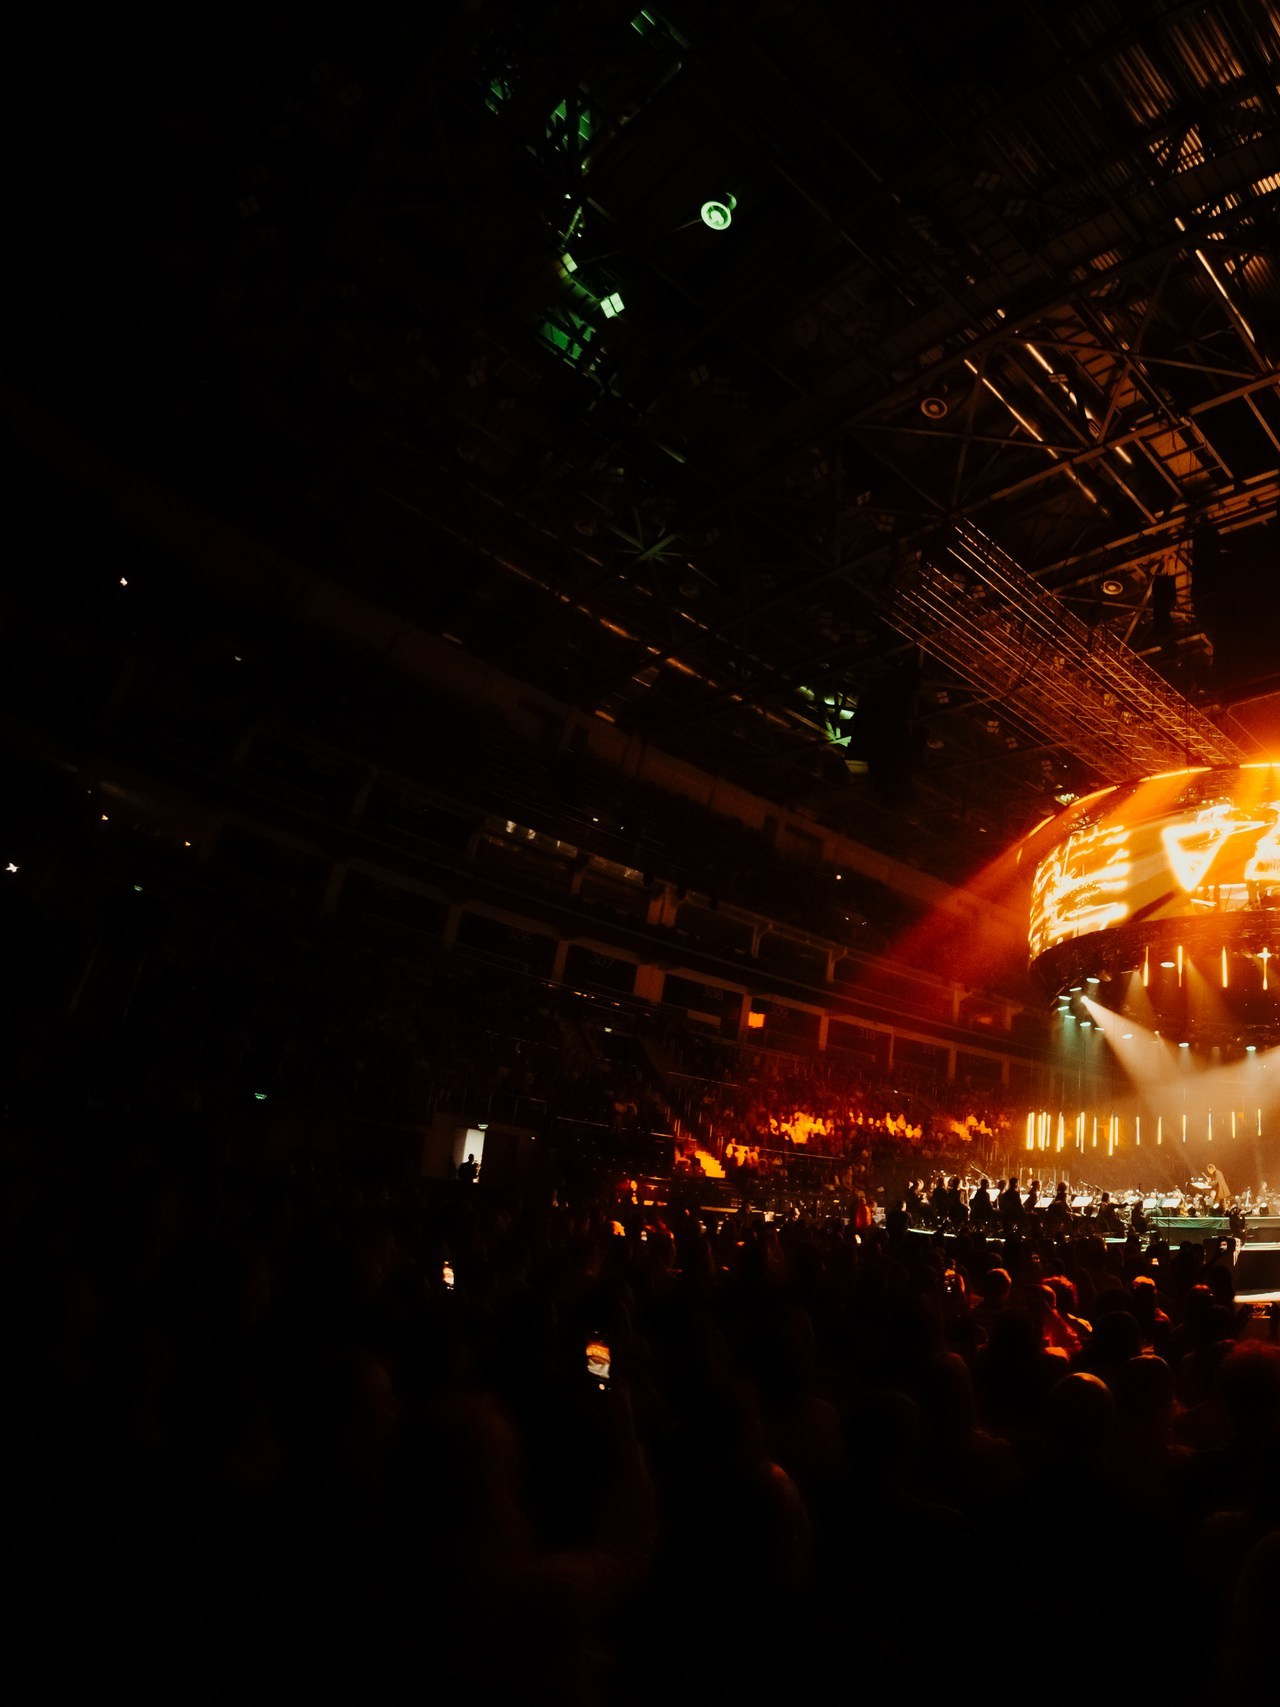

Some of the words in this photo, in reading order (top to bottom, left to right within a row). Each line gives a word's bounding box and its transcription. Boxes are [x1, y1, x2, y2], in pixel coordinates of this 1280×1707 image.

[590, 952, 615, 969] 307
[702, 985, 724, 1001] 308
[859, 1028, 876, 1041] 310
